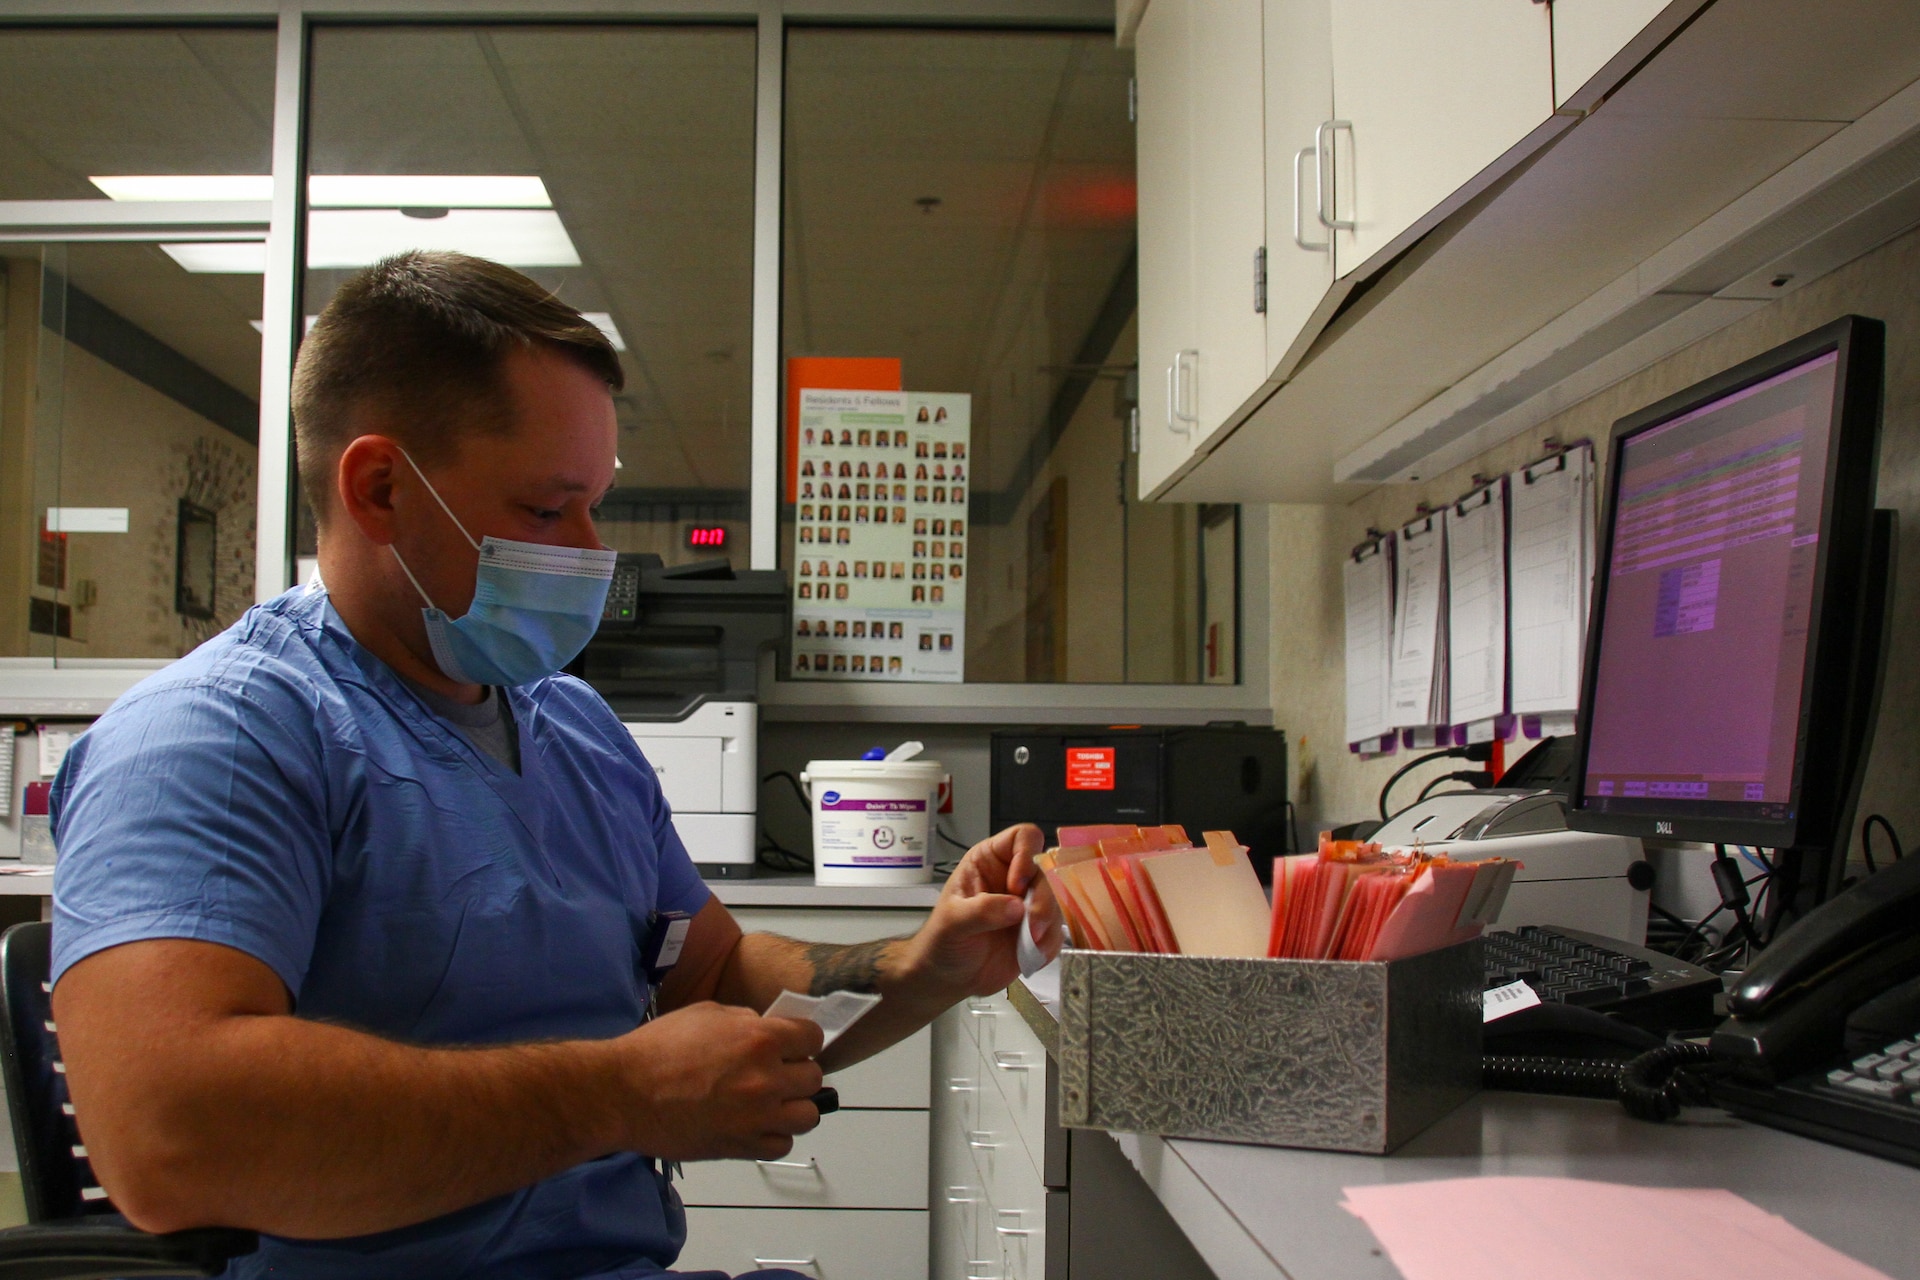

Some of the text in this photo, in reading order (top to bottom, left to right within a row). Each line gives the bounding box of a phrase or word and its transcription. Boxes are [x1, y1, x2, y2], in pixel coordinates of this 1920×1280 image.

[805, 394, 851, 404] Residents
[863, 396, 900, 406] Fellows
[1656, 821, 1672, 834] DELL
